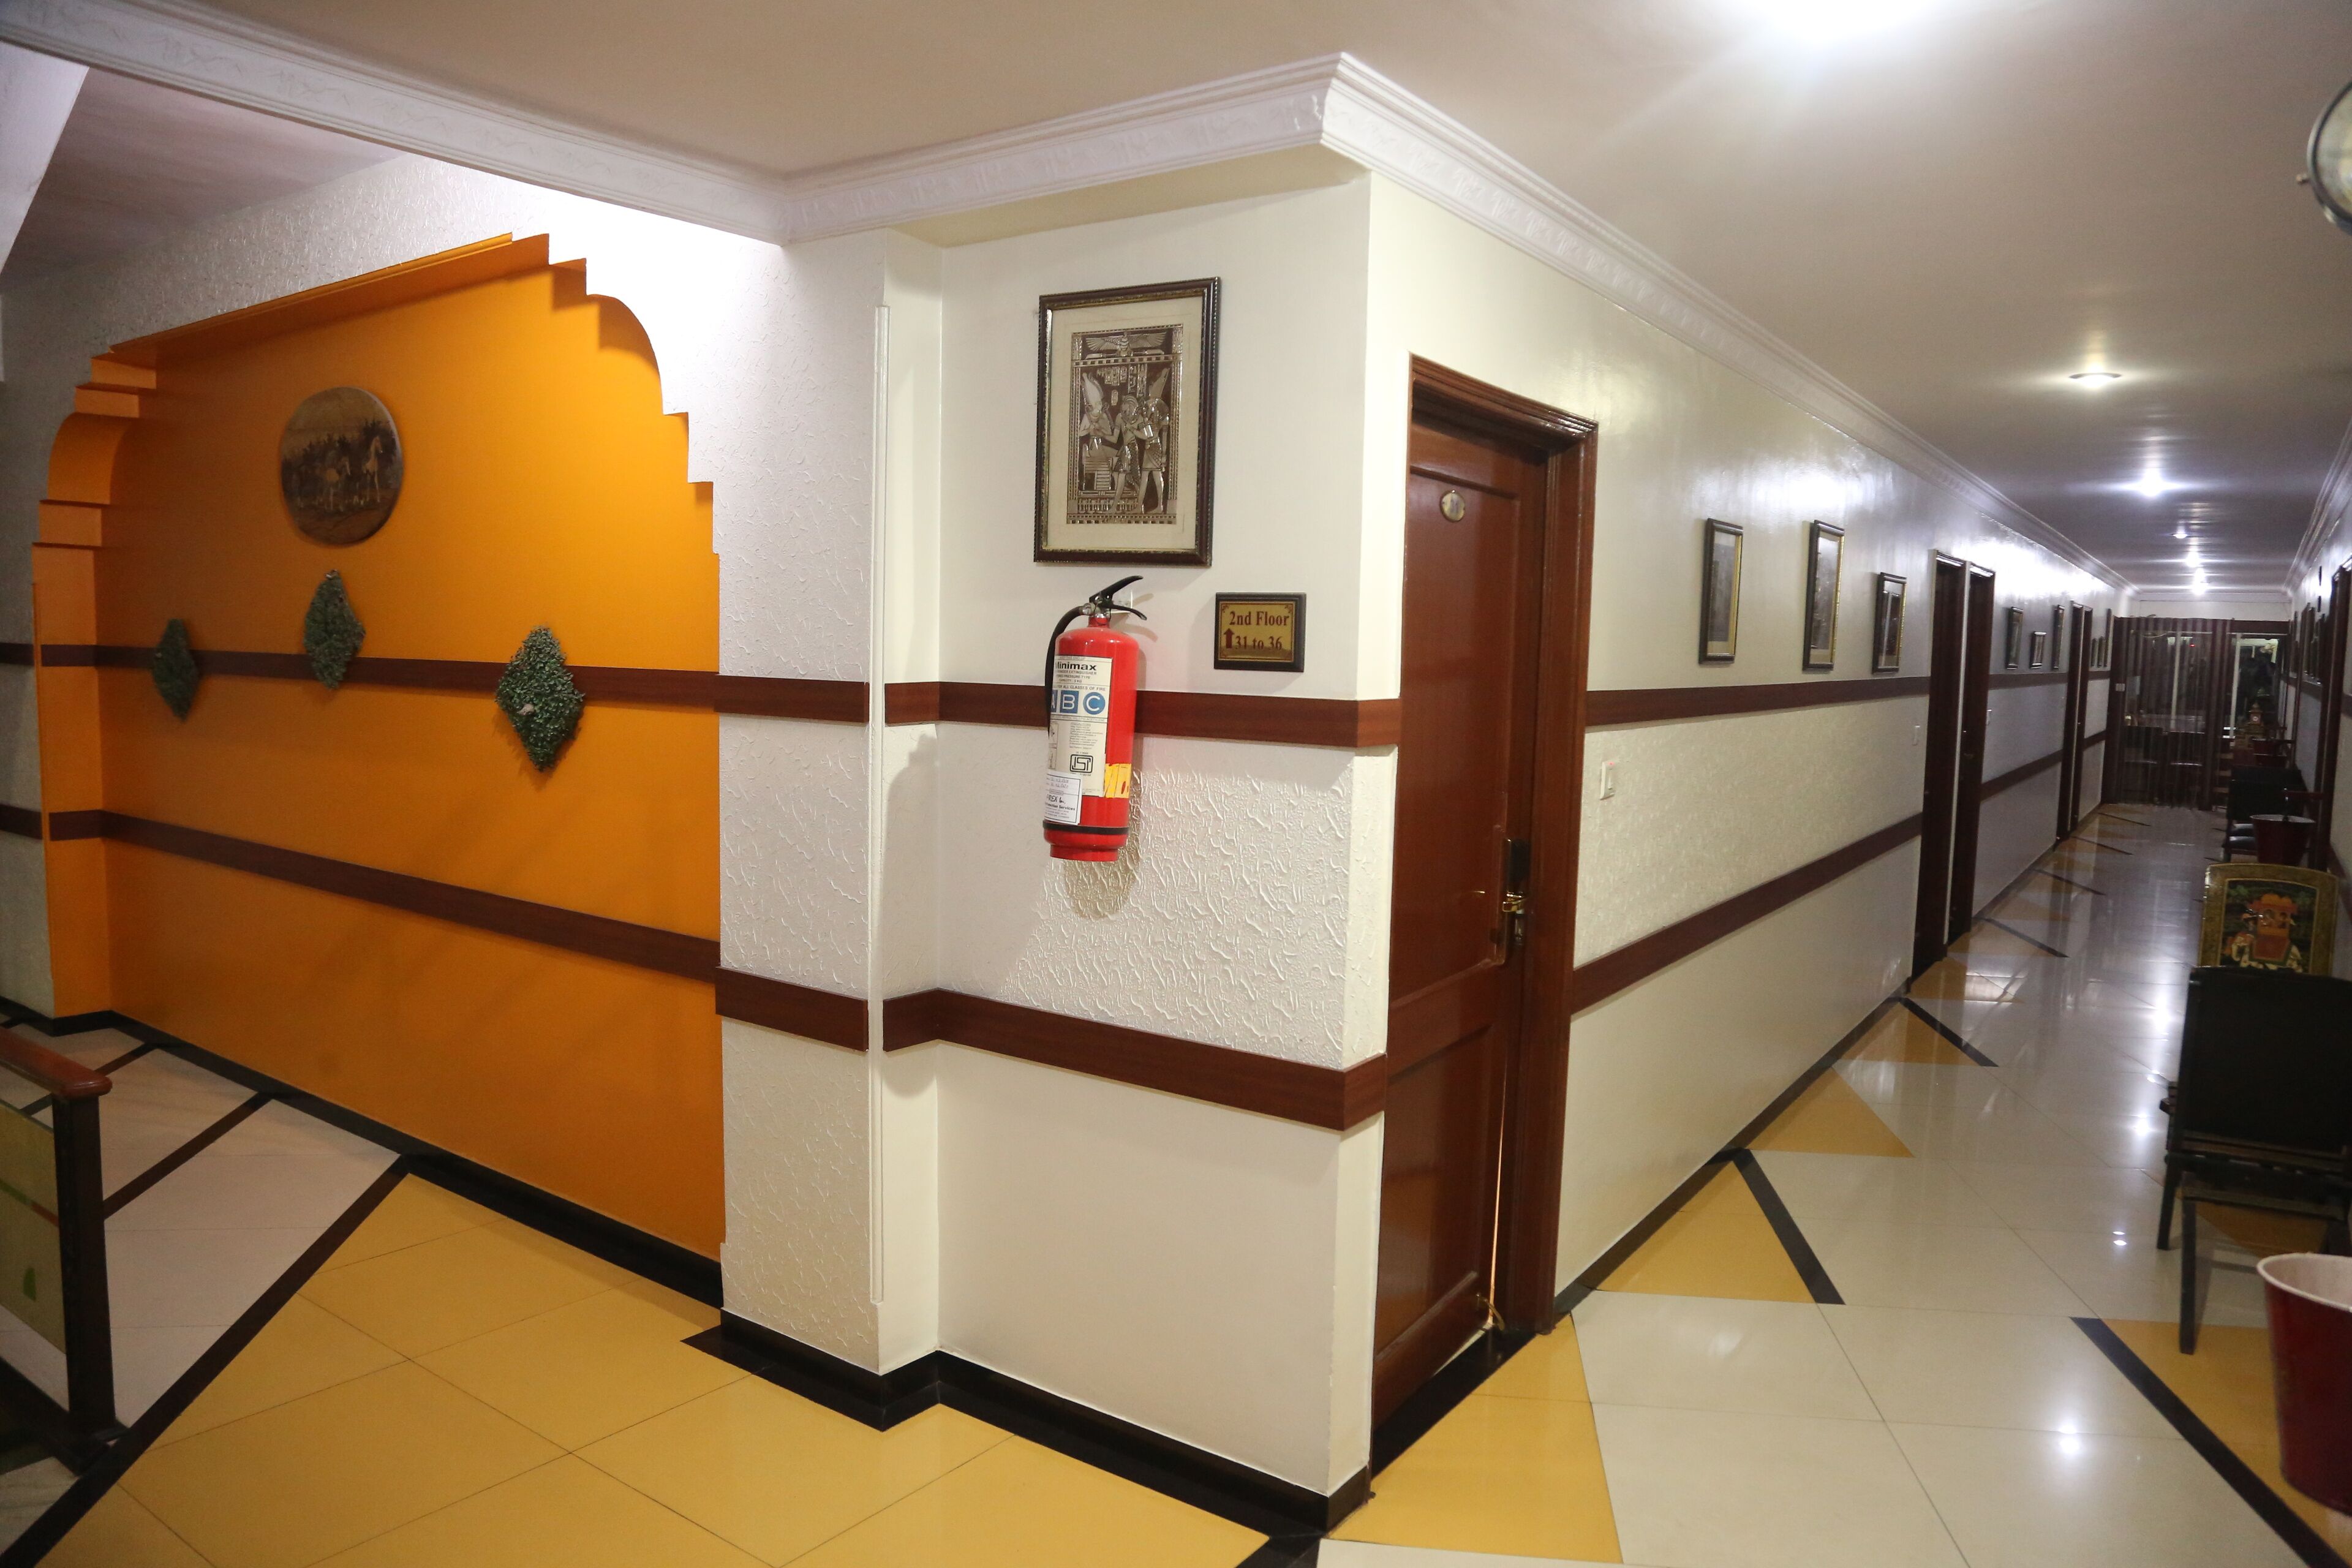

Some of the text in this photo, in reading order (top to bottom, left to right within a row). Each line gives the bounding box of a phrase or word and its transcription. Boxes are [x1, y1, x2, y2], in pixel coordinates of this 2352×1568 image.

[1229, 611, 1289, 626] 2nd Floor
[1235, 636, 1283, 650] 31 to 36
[1062, 694, 1075, 710] B
[1087, 695, 1101, 712] C
